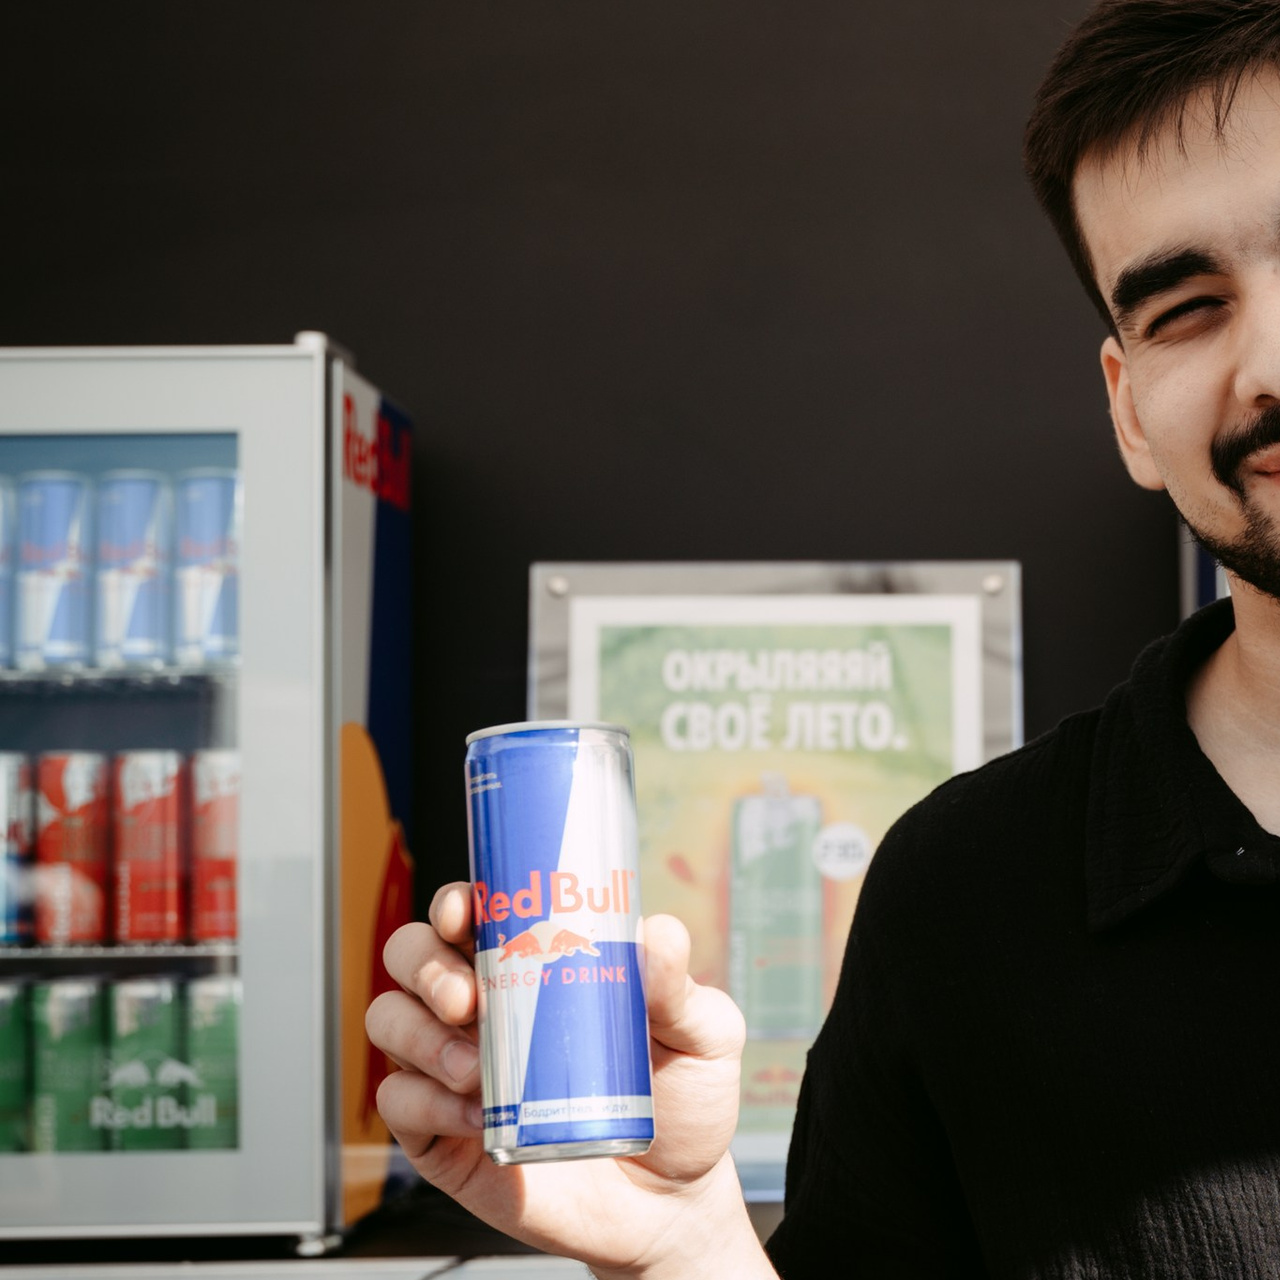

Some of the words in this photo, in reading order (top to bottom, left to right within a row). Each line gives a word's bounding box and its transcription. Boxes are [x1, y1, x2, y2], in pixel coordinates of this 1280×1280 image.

[660, 693, 774, 753] СВОЁ
[780, 700, 910, 753] ЛЕТО.
[474, 870, 543, 926] Red
[550, 869, 631, 915] Bull
[481, 968, 552, 993] ENERGY
[561, 966, 627, 985] DRINK
[90, 1094, 153, 1129] Red
[156, 1094, 216, 1129] Bull
